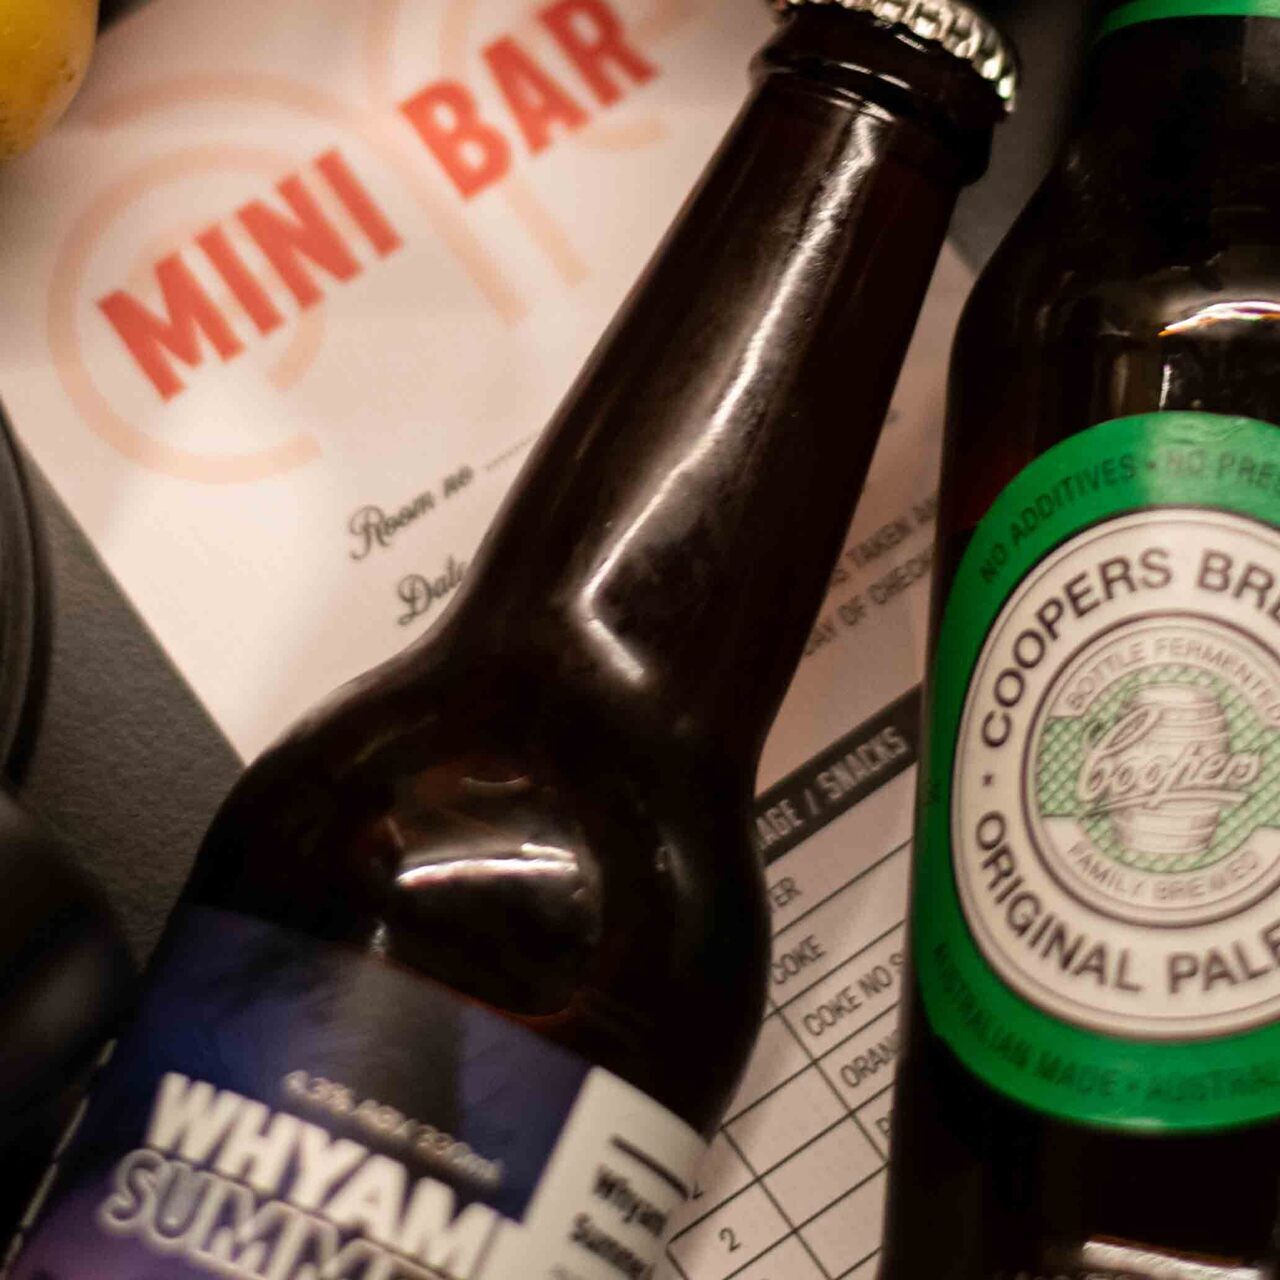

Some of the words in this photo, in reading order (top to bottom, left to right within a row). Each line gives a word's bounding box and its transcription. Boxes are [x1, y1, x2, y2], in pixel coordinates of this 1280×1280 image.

[97, 145, 404, 404] MINI
[349, 491, 435, 563] Room
[442, 465, 474, 499] no
[979, 545, 1010, 586] NO
[1008, 452, 1137, 540] ADDITIVES
[1166, 448, 1209, 477] NO
[838, 594, 866, 626] OF
[983, 546, 1174, 750] COOPERS
[755, 798, 804, 851] AGE
[816, 725, 909, 801] SNACKS
[974, 809, 1143, 996] ORIGINAL
[1067, 839, 1142, 898] FAMILY
[771, 933, 827, 985] COKE
[802, 985, 863, 1037] COKE
[857, 965, 893, 998] NO
[840, 1032, 900, 1088] ORAN
[146, 1070, 501, 1280] WHYAM
[719, 1226, 742, 1253] 2
